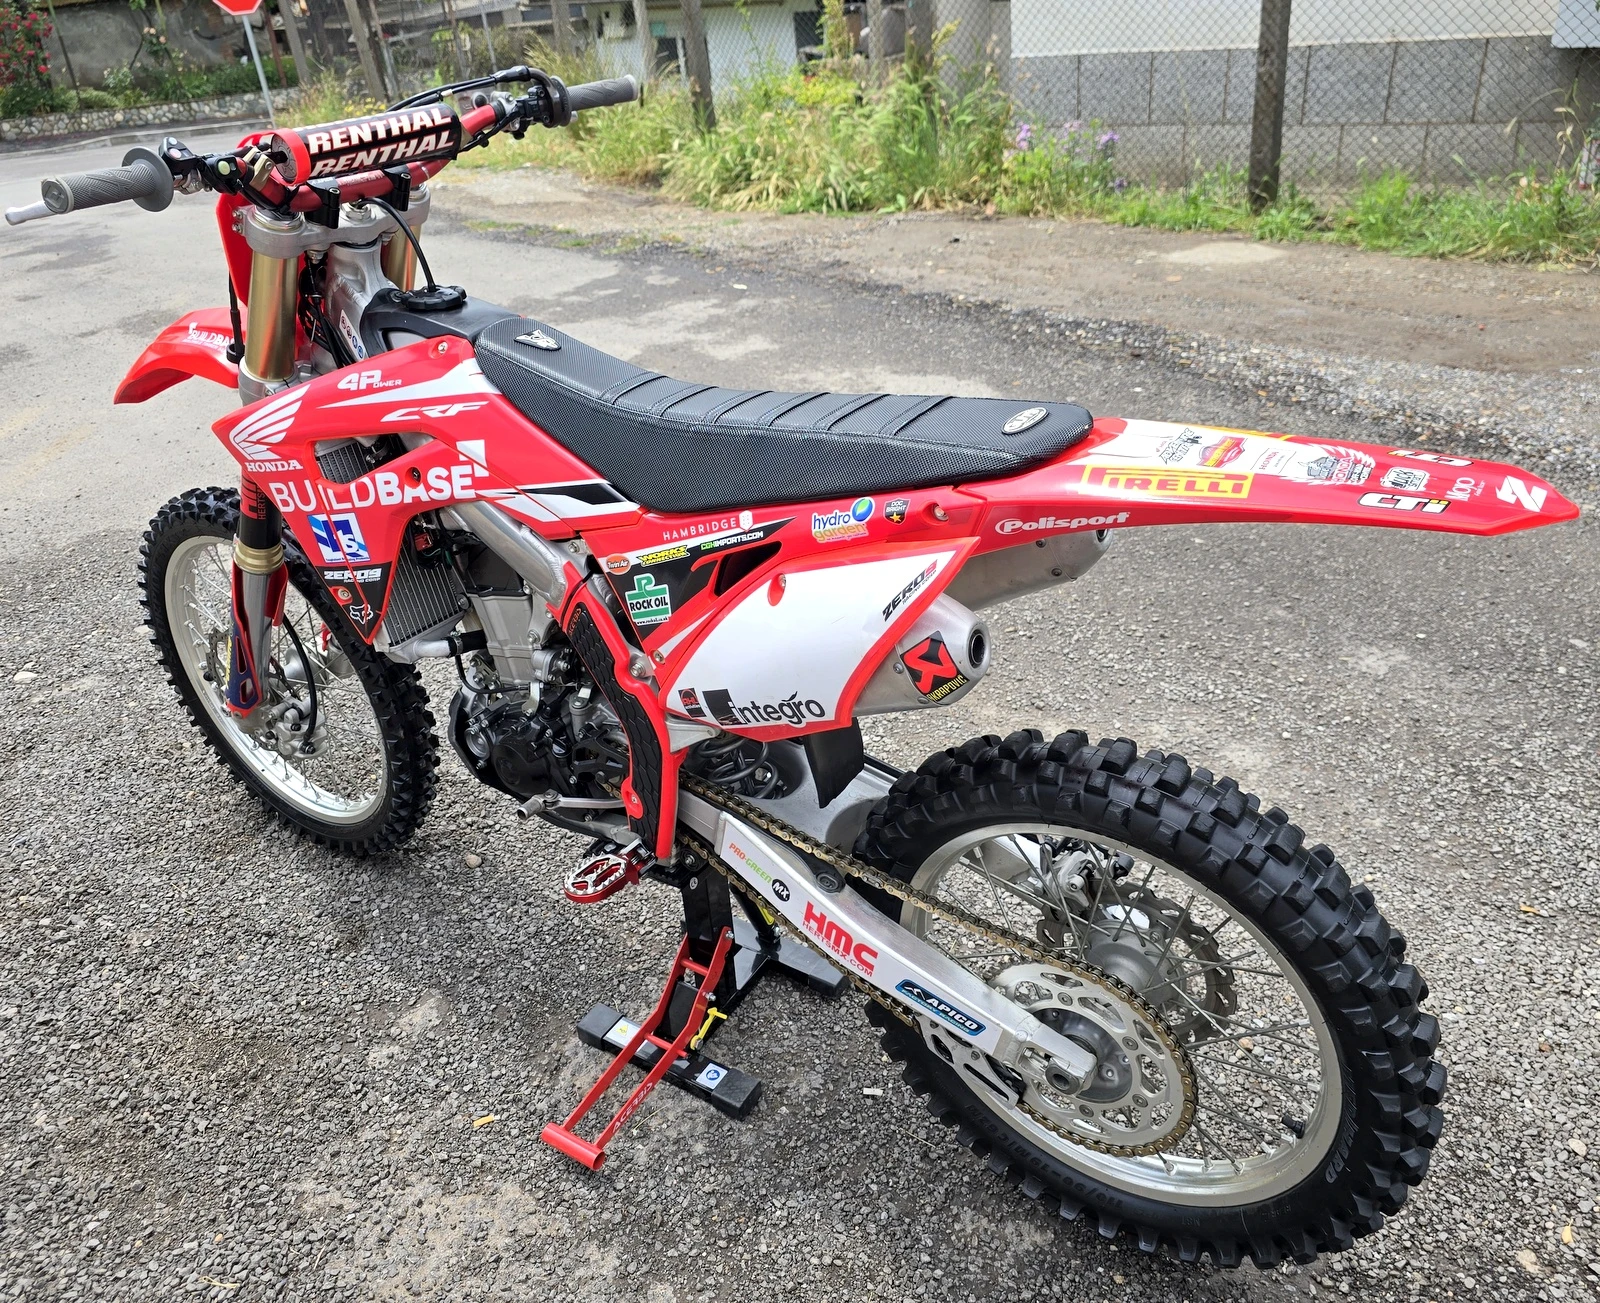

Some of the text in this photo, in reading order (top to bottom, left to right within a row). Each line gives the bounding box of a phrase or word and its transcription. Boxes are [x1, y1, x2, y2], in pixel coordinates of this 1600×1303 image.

[306, 107, 452, 155] RENTHAL
[309, 130, 455, 178] RENTHAL
[380, 401, 490, 422] CRF
[244, 460, 303, 472] HONDA
[268, 463, 477, 513] BUILDBASE
[1086, 465, 1250, 495] PIRELLI
[663, 517, 737, 541] HAMBRIDGE
[813, 511, 851, 530] hydro
[814, 523, 866, 542] garden
[1001, 512, 1130, 535] Polisport
[700, 531, 764, 551] CGHIMPORTS.COM
[324, 568, 382, 580] ZERO9
[620, 559, 629, 567] Air
[629, 596, 668, 612] ROCK OIL
[882, 559, 938, 623] ZERO9
[730, 693, 826, 725] integro
[729, 842, 772, 884] PRO-GREEN
[802, 921, 873, 977] HERTSMX.COM
[803, 901, 878, 973] HMC
[927, 995, 979, 1031] APICO
